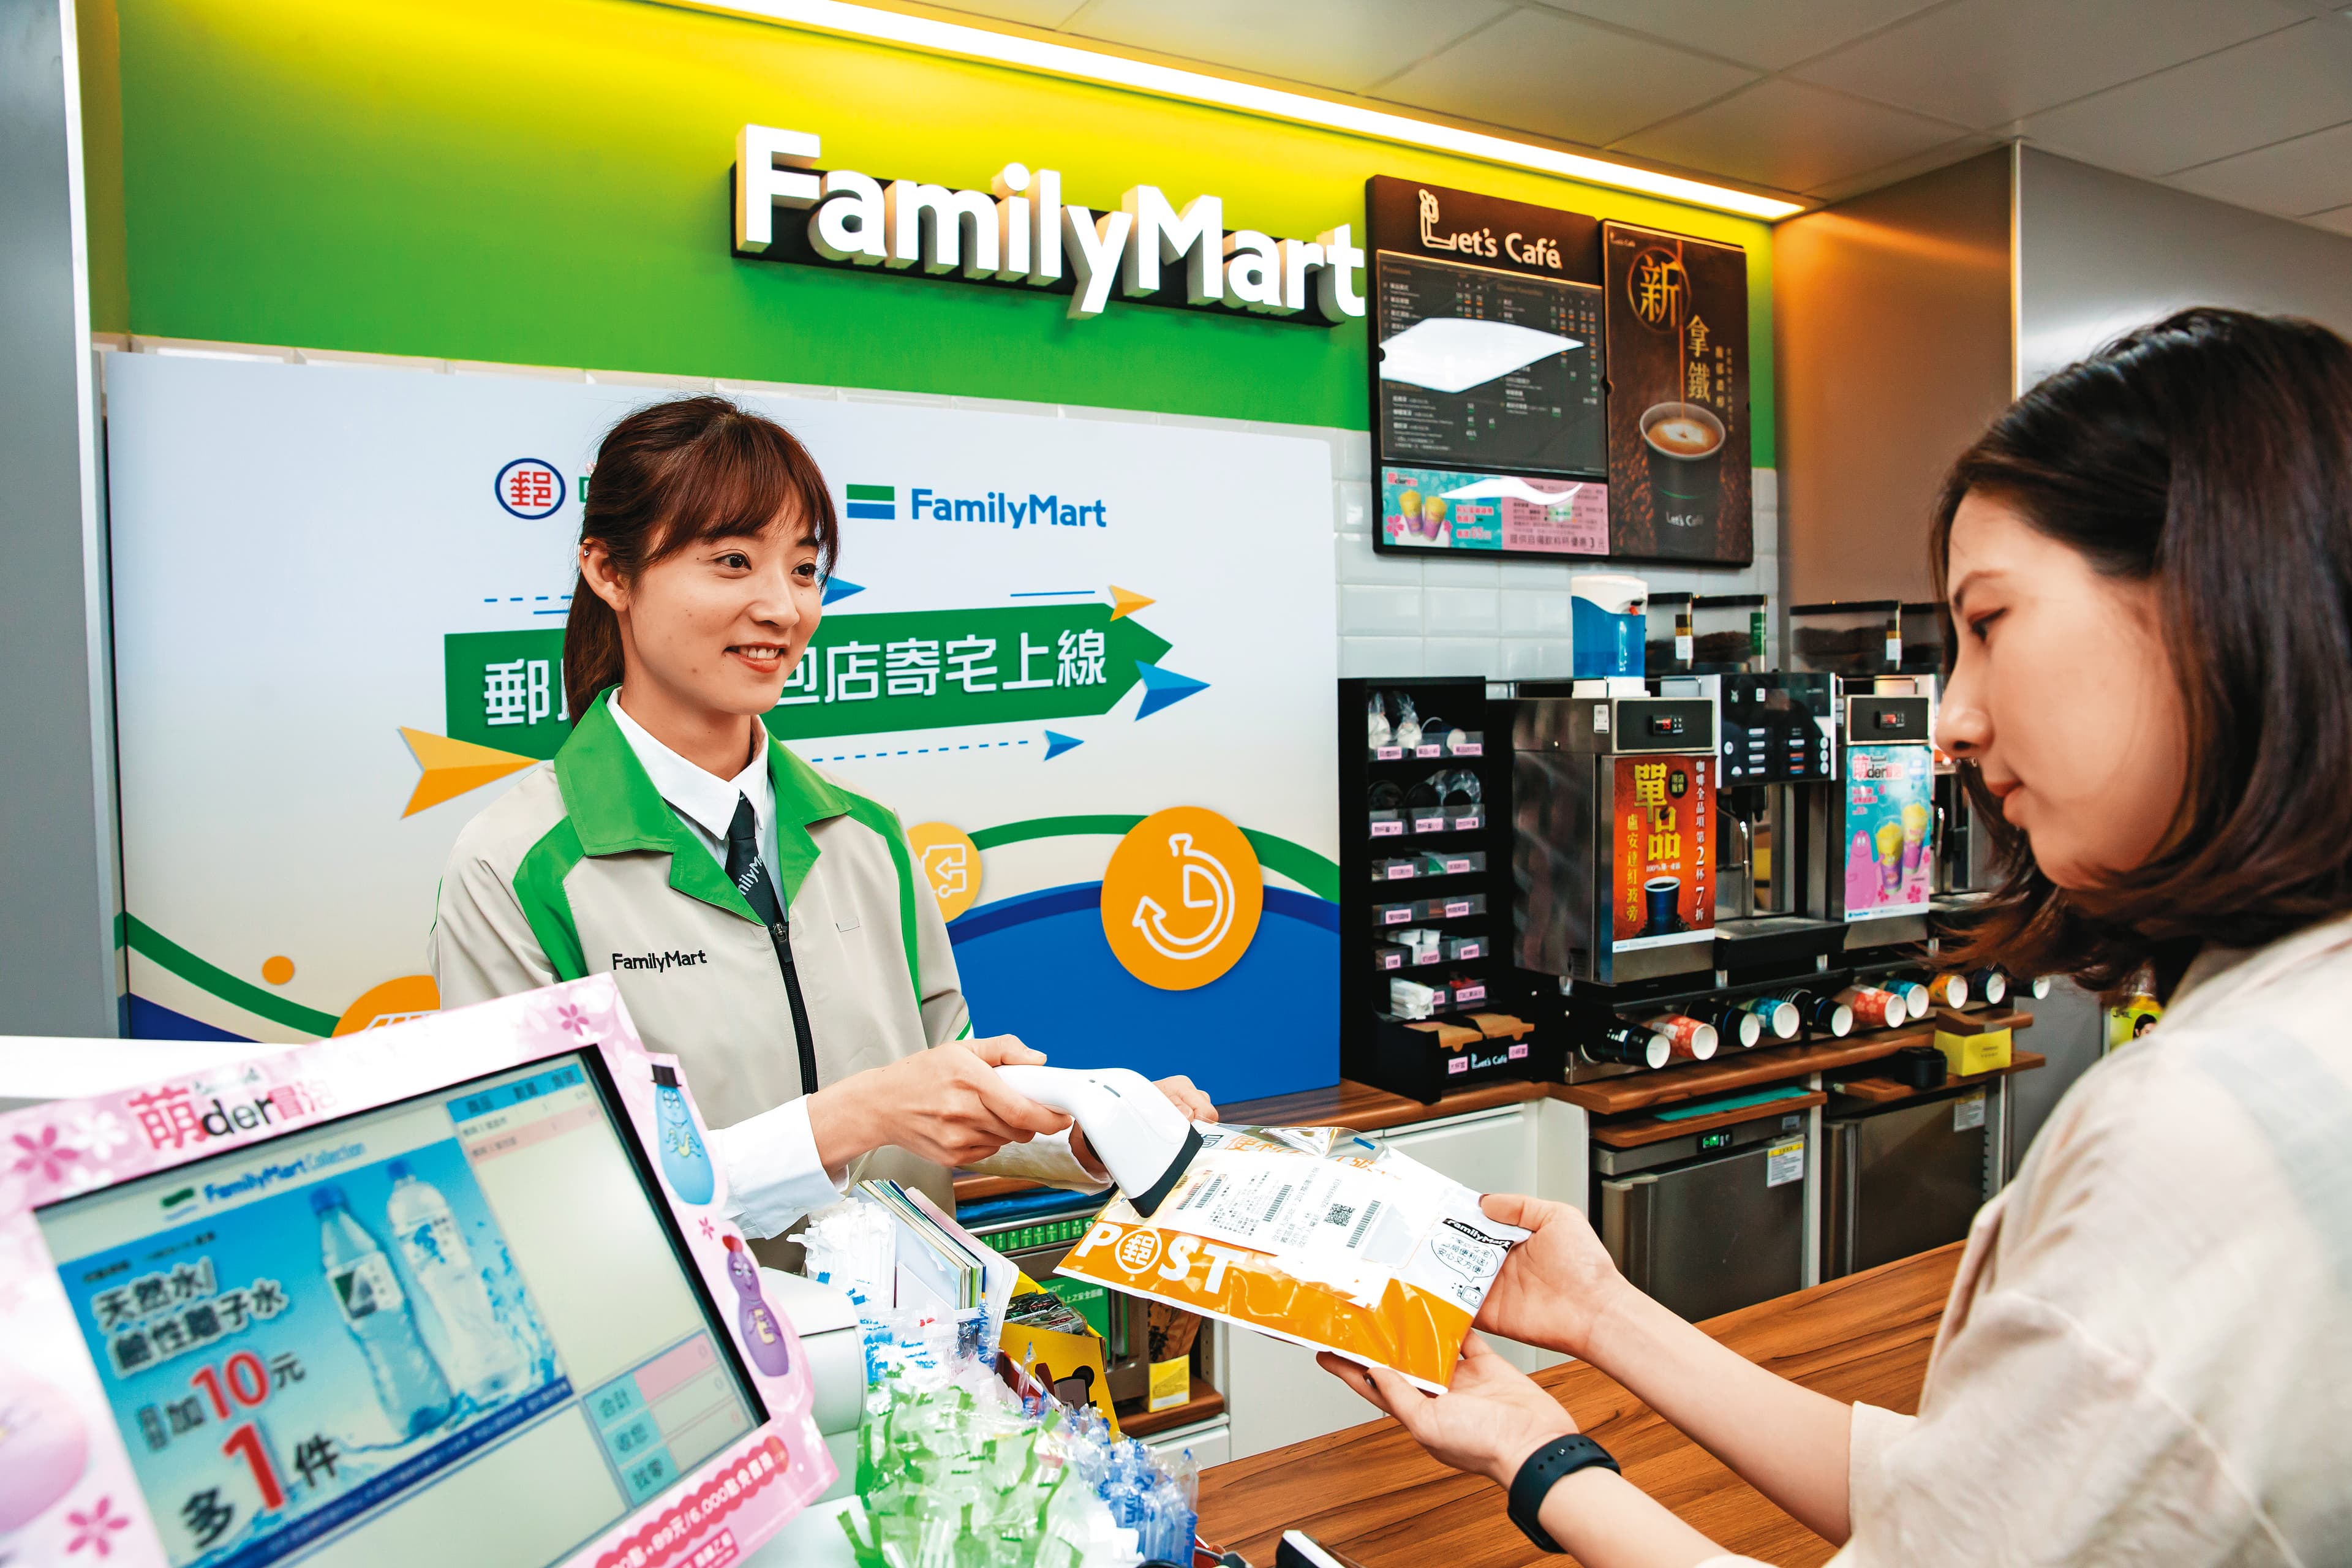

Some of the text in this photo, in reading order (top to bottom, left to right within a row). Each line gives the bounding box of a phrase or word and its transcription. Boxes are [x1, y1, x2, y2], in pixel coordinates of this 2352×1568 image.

[737, 124, 1365, 319] FamilyMart
[1419, 189, 1563, 270] Let's Café
[1639, 254, 1681, 329] 新
[1686, 314, 1711, 402] 拿鐵
[912, 489, 1107, 530] FamilyMart
[1634, 762, 1681, 862] 單品
[612, 949, 707, 973] FamilyMart
[204, 1156, 307, 1203] FamilyMart
[1447, 1218, 1511, 1248] FamilyMart
